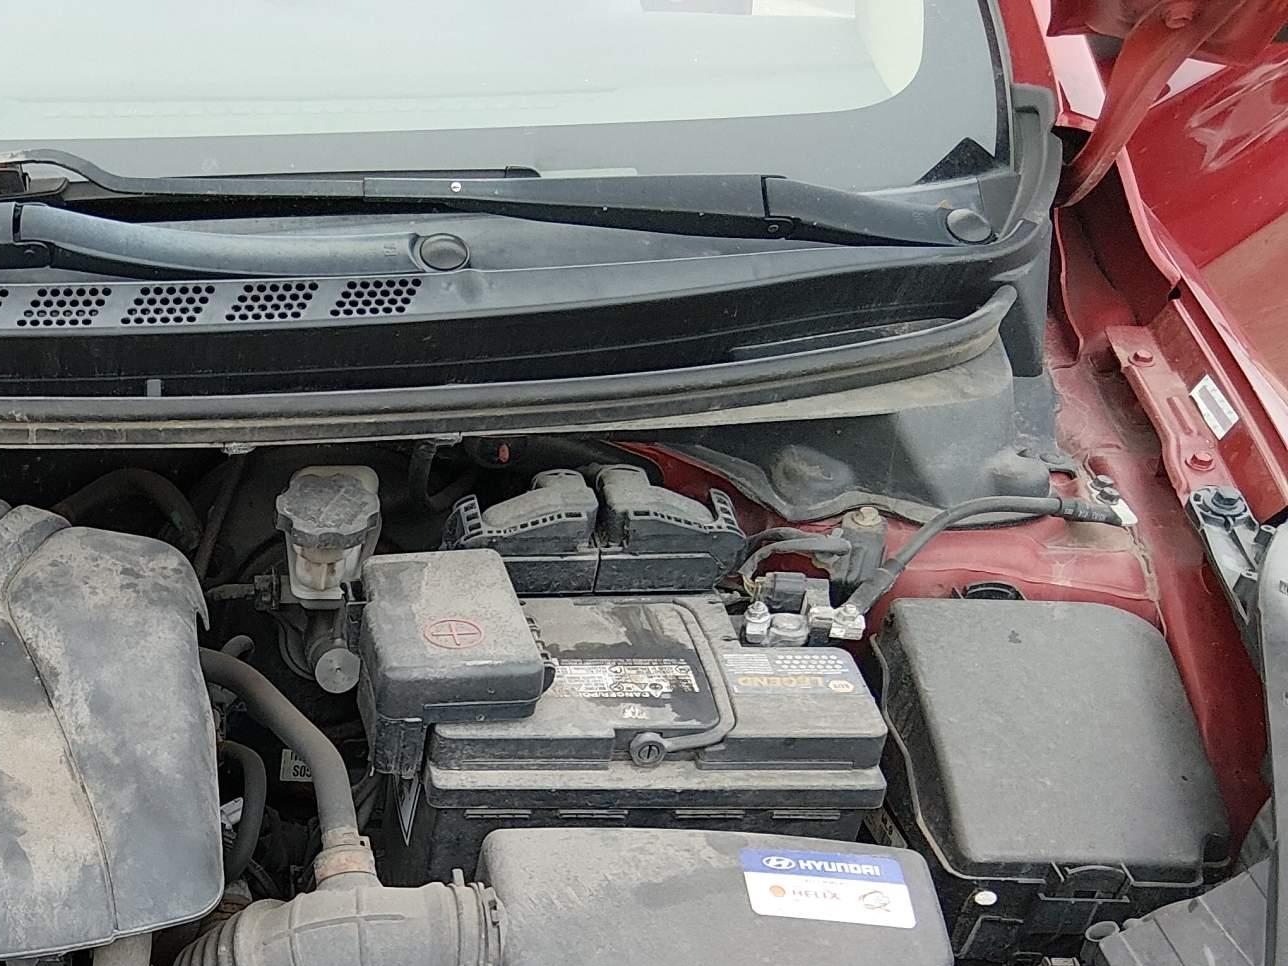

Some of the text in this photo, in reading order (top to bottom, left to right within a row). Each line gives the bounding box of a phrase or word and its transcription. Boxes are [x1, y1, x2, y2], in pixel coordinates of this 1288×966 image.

[738, 675, 825, 689] LEGEND
[798, 860, 880, 876] HYUNDAI
[792, 889, 840, 900] HELIX
